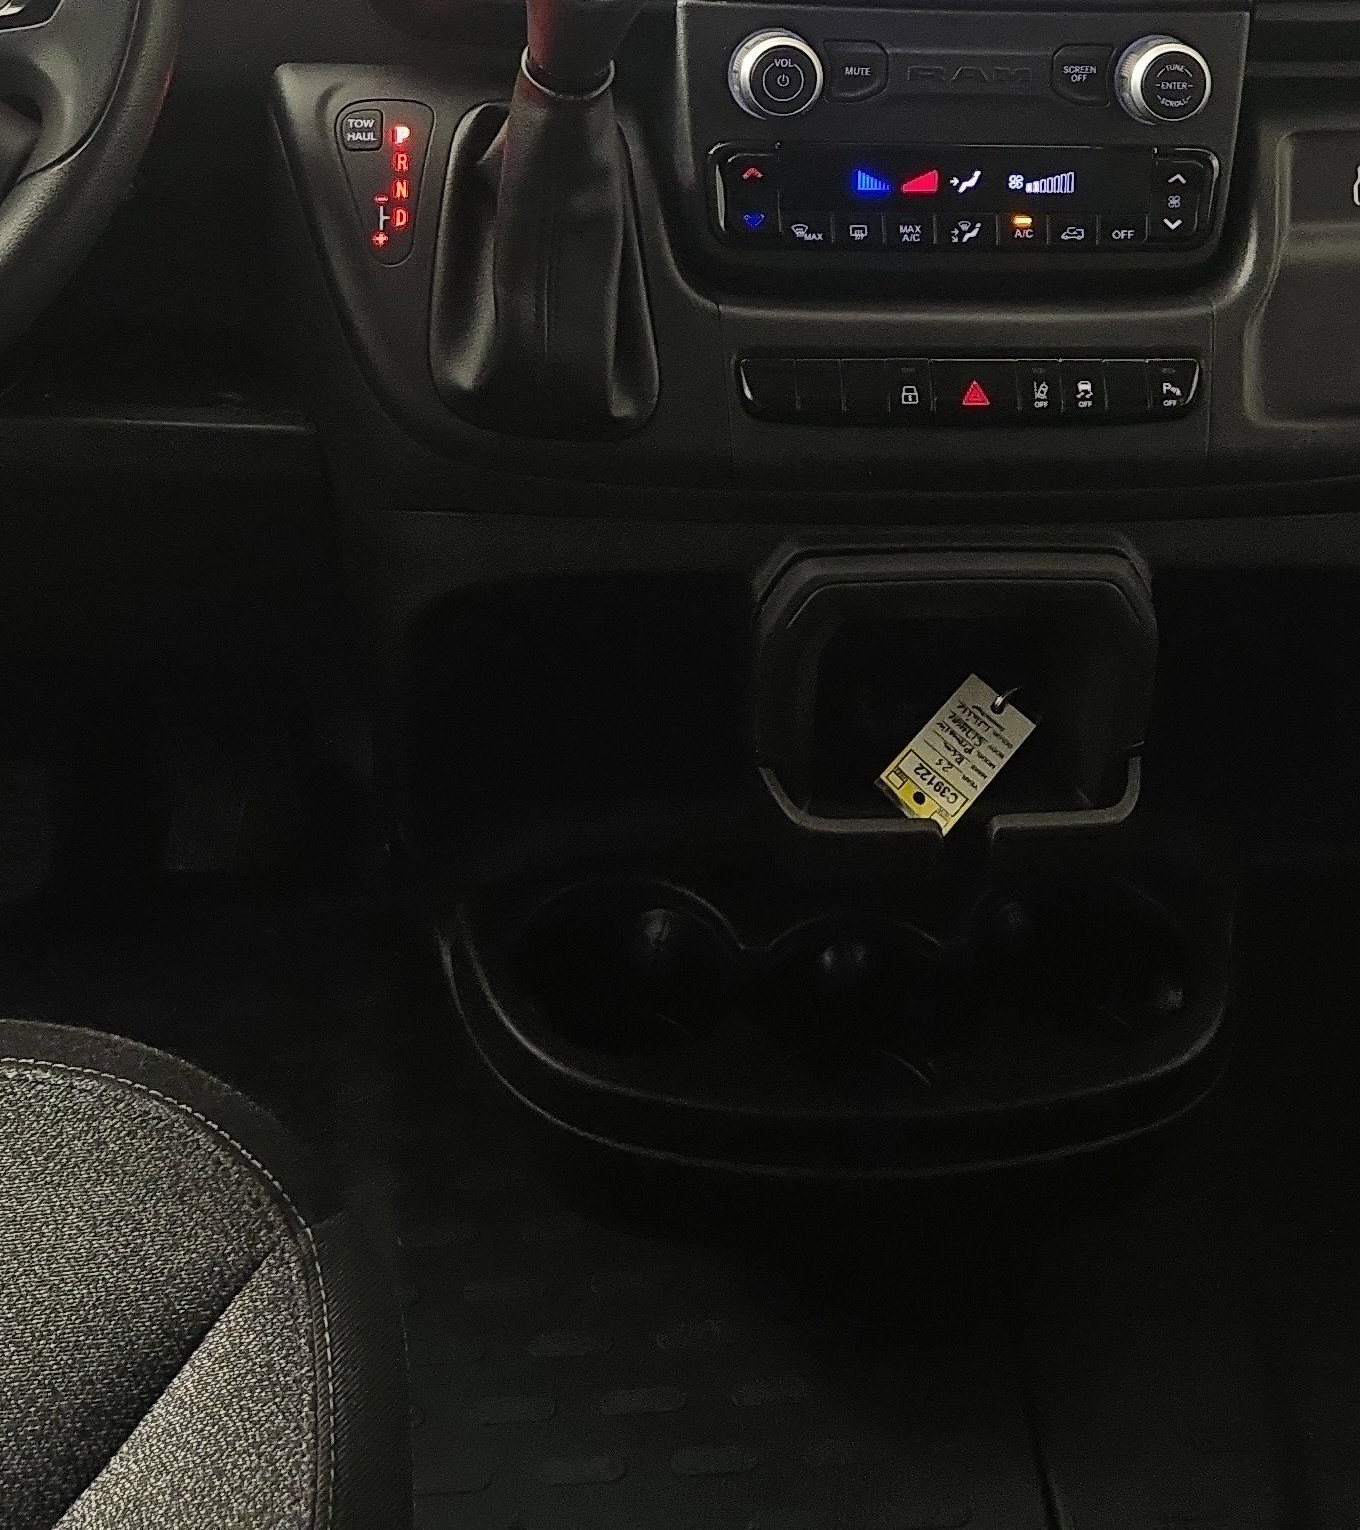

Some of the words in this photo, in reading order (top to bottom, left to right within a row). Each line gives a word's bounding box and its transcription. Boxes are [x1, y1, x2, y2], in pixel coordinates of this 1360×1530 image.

[774, 59, 794, 67] VOL
[845, 67, 871, 76] MUTE
[1165, 64, 1185, 72] TUNE
[1071, 74, 1087, 82] OFF
[1161, 82, 1187, 90] ENTER
[1160, 98, 1188, 107] SCROLL
[347, 119, 374, 128] TOW
[347, 133, 377, 142] HAUL
[395, 126, 410, 144] P
[396, 154, 409, 171] R
[395, 180, 409, 198] N
[394, 208, 408, 227] D
[900, 225, 921, 234] MAX
[1014, 229, 1033, 238] A/C
[902, 234, 920, 242] A/C
[1112, 230, 1135, 239] OFF
[914, 763, 958, 804] C39122
